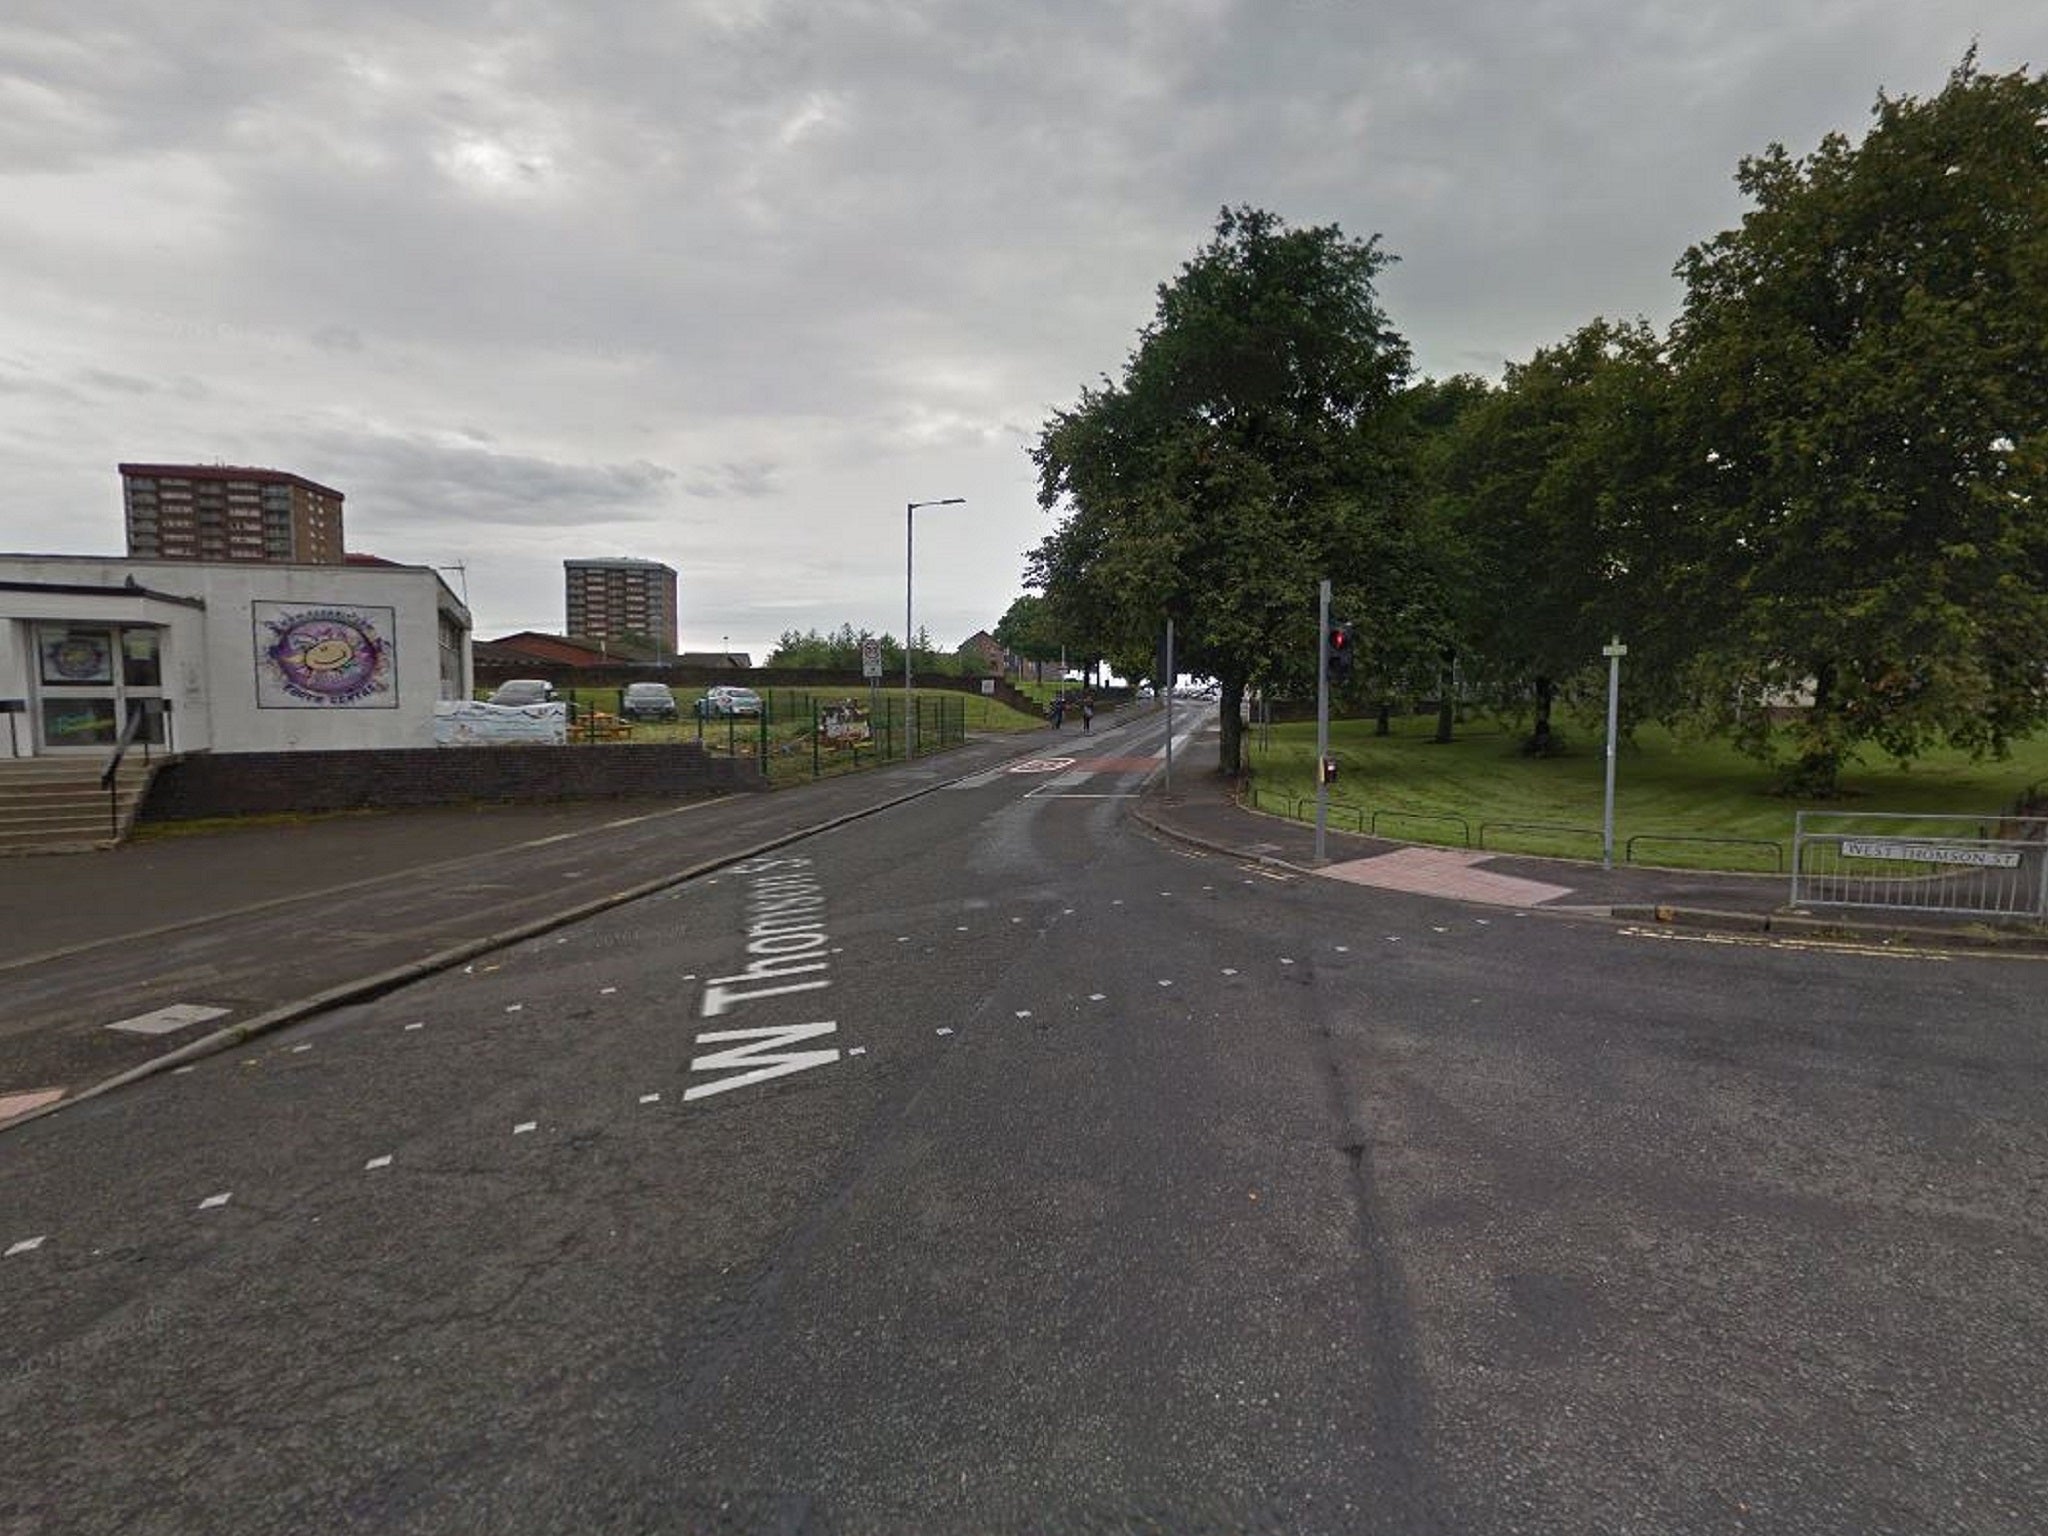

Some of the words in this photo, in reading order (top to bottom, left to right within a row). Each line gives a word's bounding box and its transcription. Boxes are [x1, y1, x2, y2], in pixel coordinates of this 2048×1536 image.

[1847, 843, 1893, 857] WEST
[1902, 847, 1986, 864] THOMSON
[703, 871, 833, 1016] Thomson
